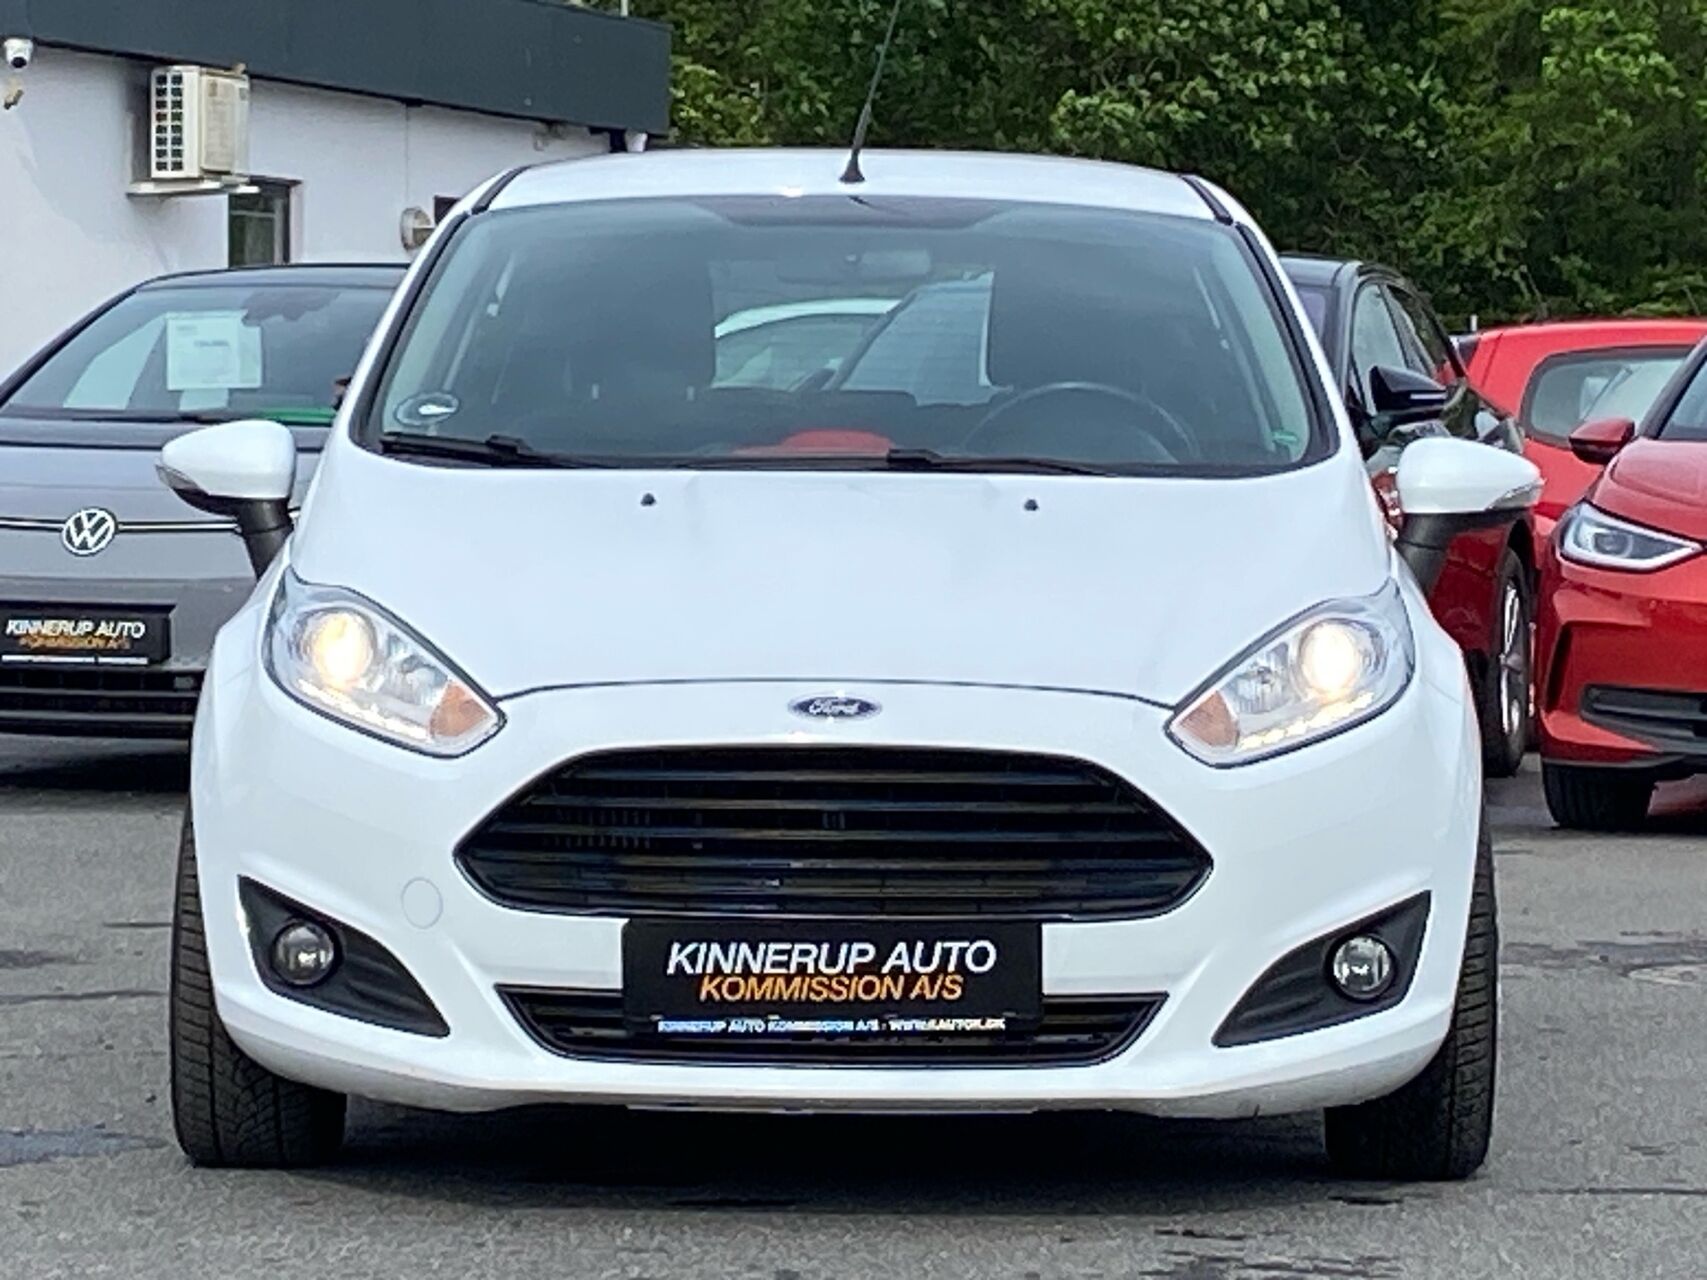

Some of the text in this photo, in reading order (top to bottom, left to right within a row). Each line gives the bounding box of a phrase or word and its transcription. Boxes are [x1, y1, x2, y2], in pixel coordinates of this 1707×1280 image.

[6, 619, 146, 639] KINNERUP AUTO
[666, 940, 997, 975] KINNERUP AUTO
[699, 974, 964, 1002] KOMMISSION A/S
[728, 1019, 766, 1033] AUTO
